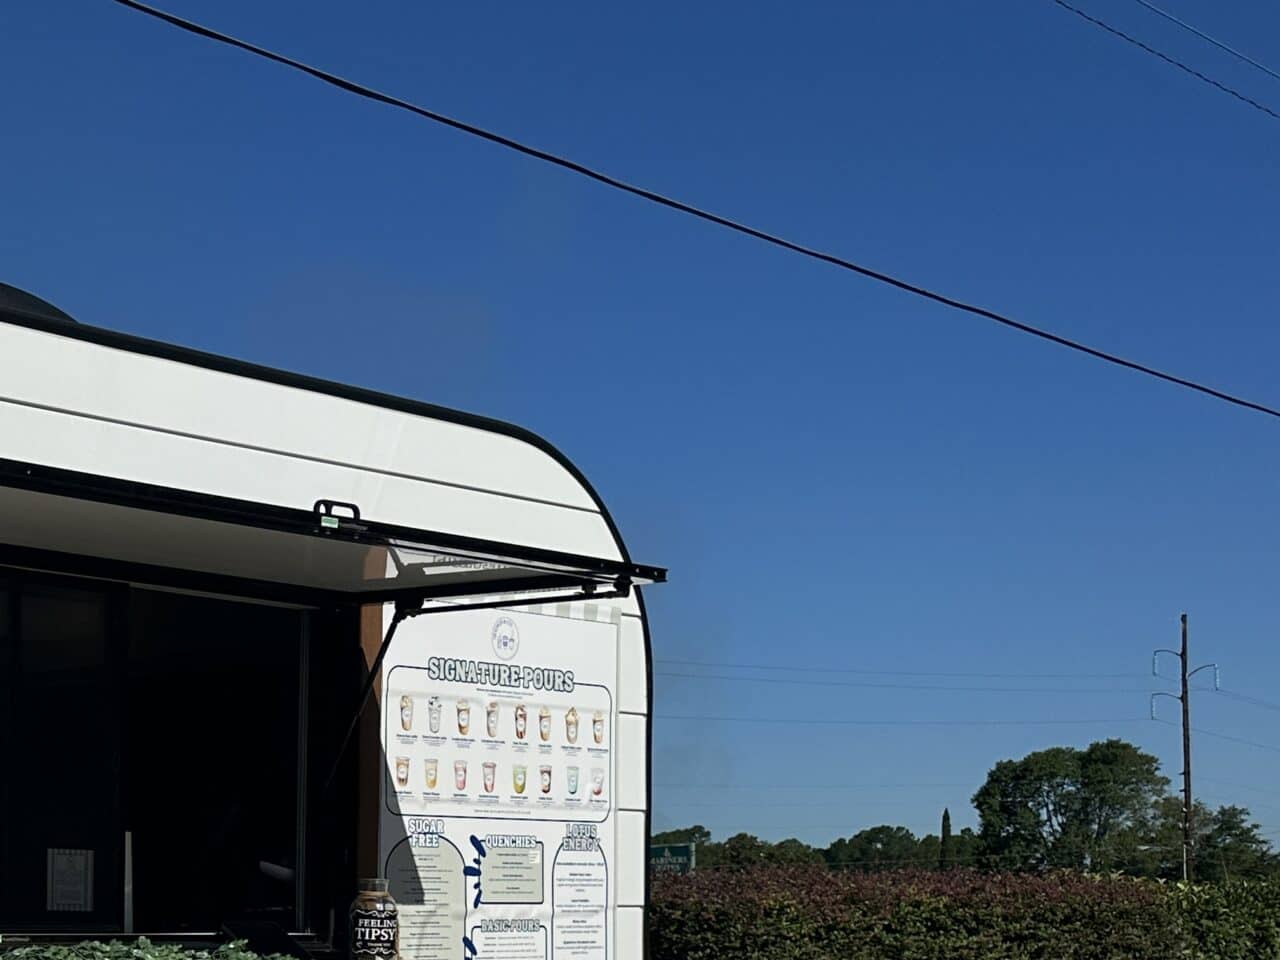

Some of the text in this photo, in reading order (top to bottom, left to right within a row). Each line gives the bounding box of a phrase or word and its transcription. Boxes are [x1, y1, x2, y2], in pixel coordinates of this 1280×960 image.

[428, 656, 575, 692] SIGNATURE POURS
[408, 819, 444, 835] SUGAR
[565, 823, 598, 838] LOTUS
[410, 833, 440, 848] FREE
[484, 835, 537, 849] QUENCHIES
[562, 836, 602, 852] ENERGY
[481, 918, 540, 932] BASIC POURS
[355, 928, 396, 940] TIPSY
